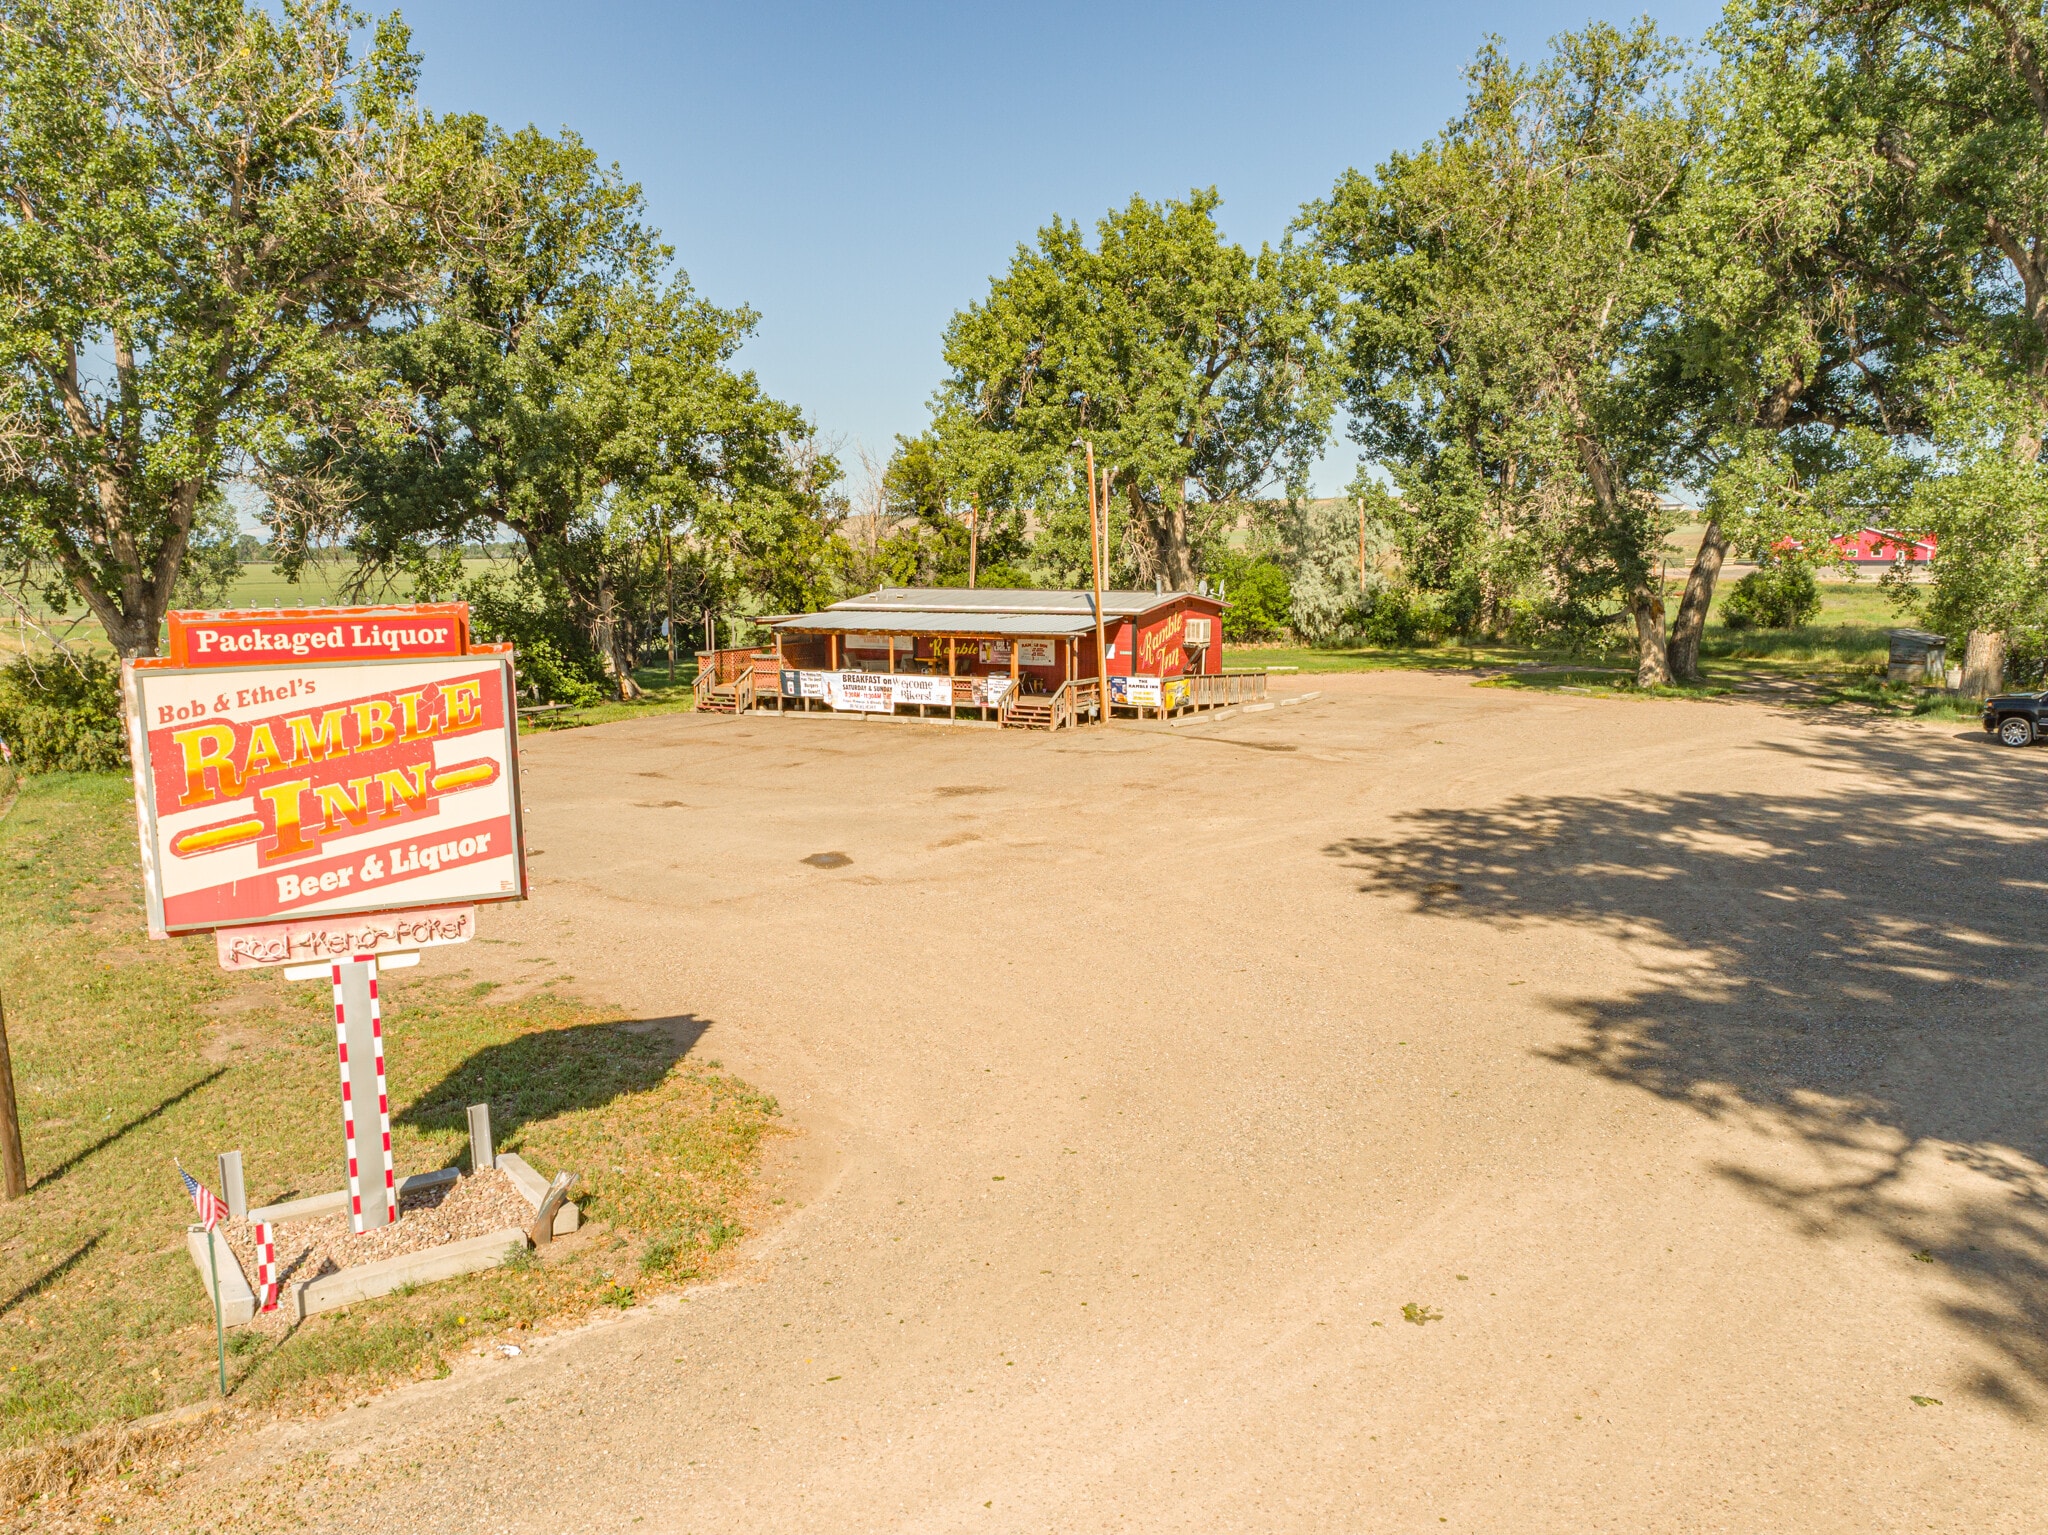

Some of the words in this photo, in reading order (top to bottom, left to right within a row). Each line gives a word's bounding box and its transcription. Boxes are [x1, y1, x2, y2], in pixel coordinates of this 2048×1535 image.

[196, 625, 345, 653] Packaged
[351, 624, 448, 653] Liquor
[1139, 611, 1183, 665] Ramble
[1156, 644, 1179, 678] Inn
[158, 701, 206, 724] Bob
[212, 693, 231, 713] &
[236, 678, 316, 707] Ethel's
[842, 674, 881, 684] BREAKFAST
[173, 679, 483, 807] RAMBLE
[259, 761, 432, 861] INN
[277, 865, 353, 903] Beer
[360, 855, 385, 881] &
[390, 833, 491, 876] Liquor
